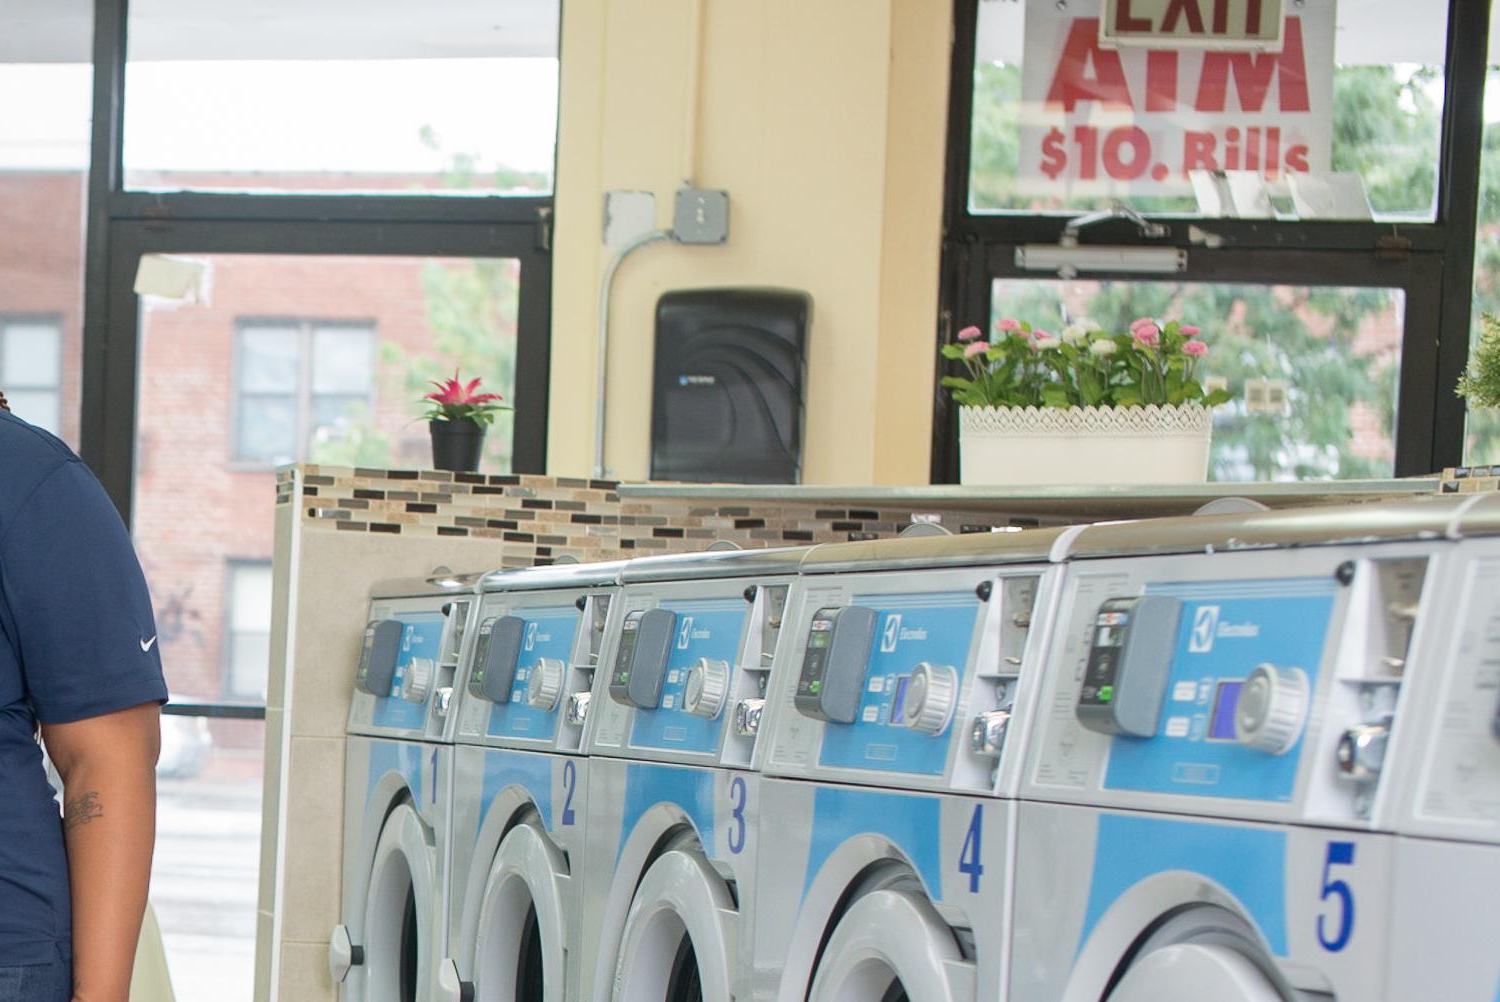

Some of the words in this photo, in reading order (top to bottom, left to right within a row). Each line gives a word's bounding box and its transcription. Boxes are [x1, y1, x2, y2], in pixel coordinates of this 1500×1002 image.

[1039, 126, 1170, 181] $10.
[1182, 126, 1311, 181] Bills
[430, 749, 438, 805] 1
[562, 760, 576, 826] 2
[727, 776, 746, 855] 3
[959, 803, 984, 894] 4
[1317, 841, 1355, 953] 5
